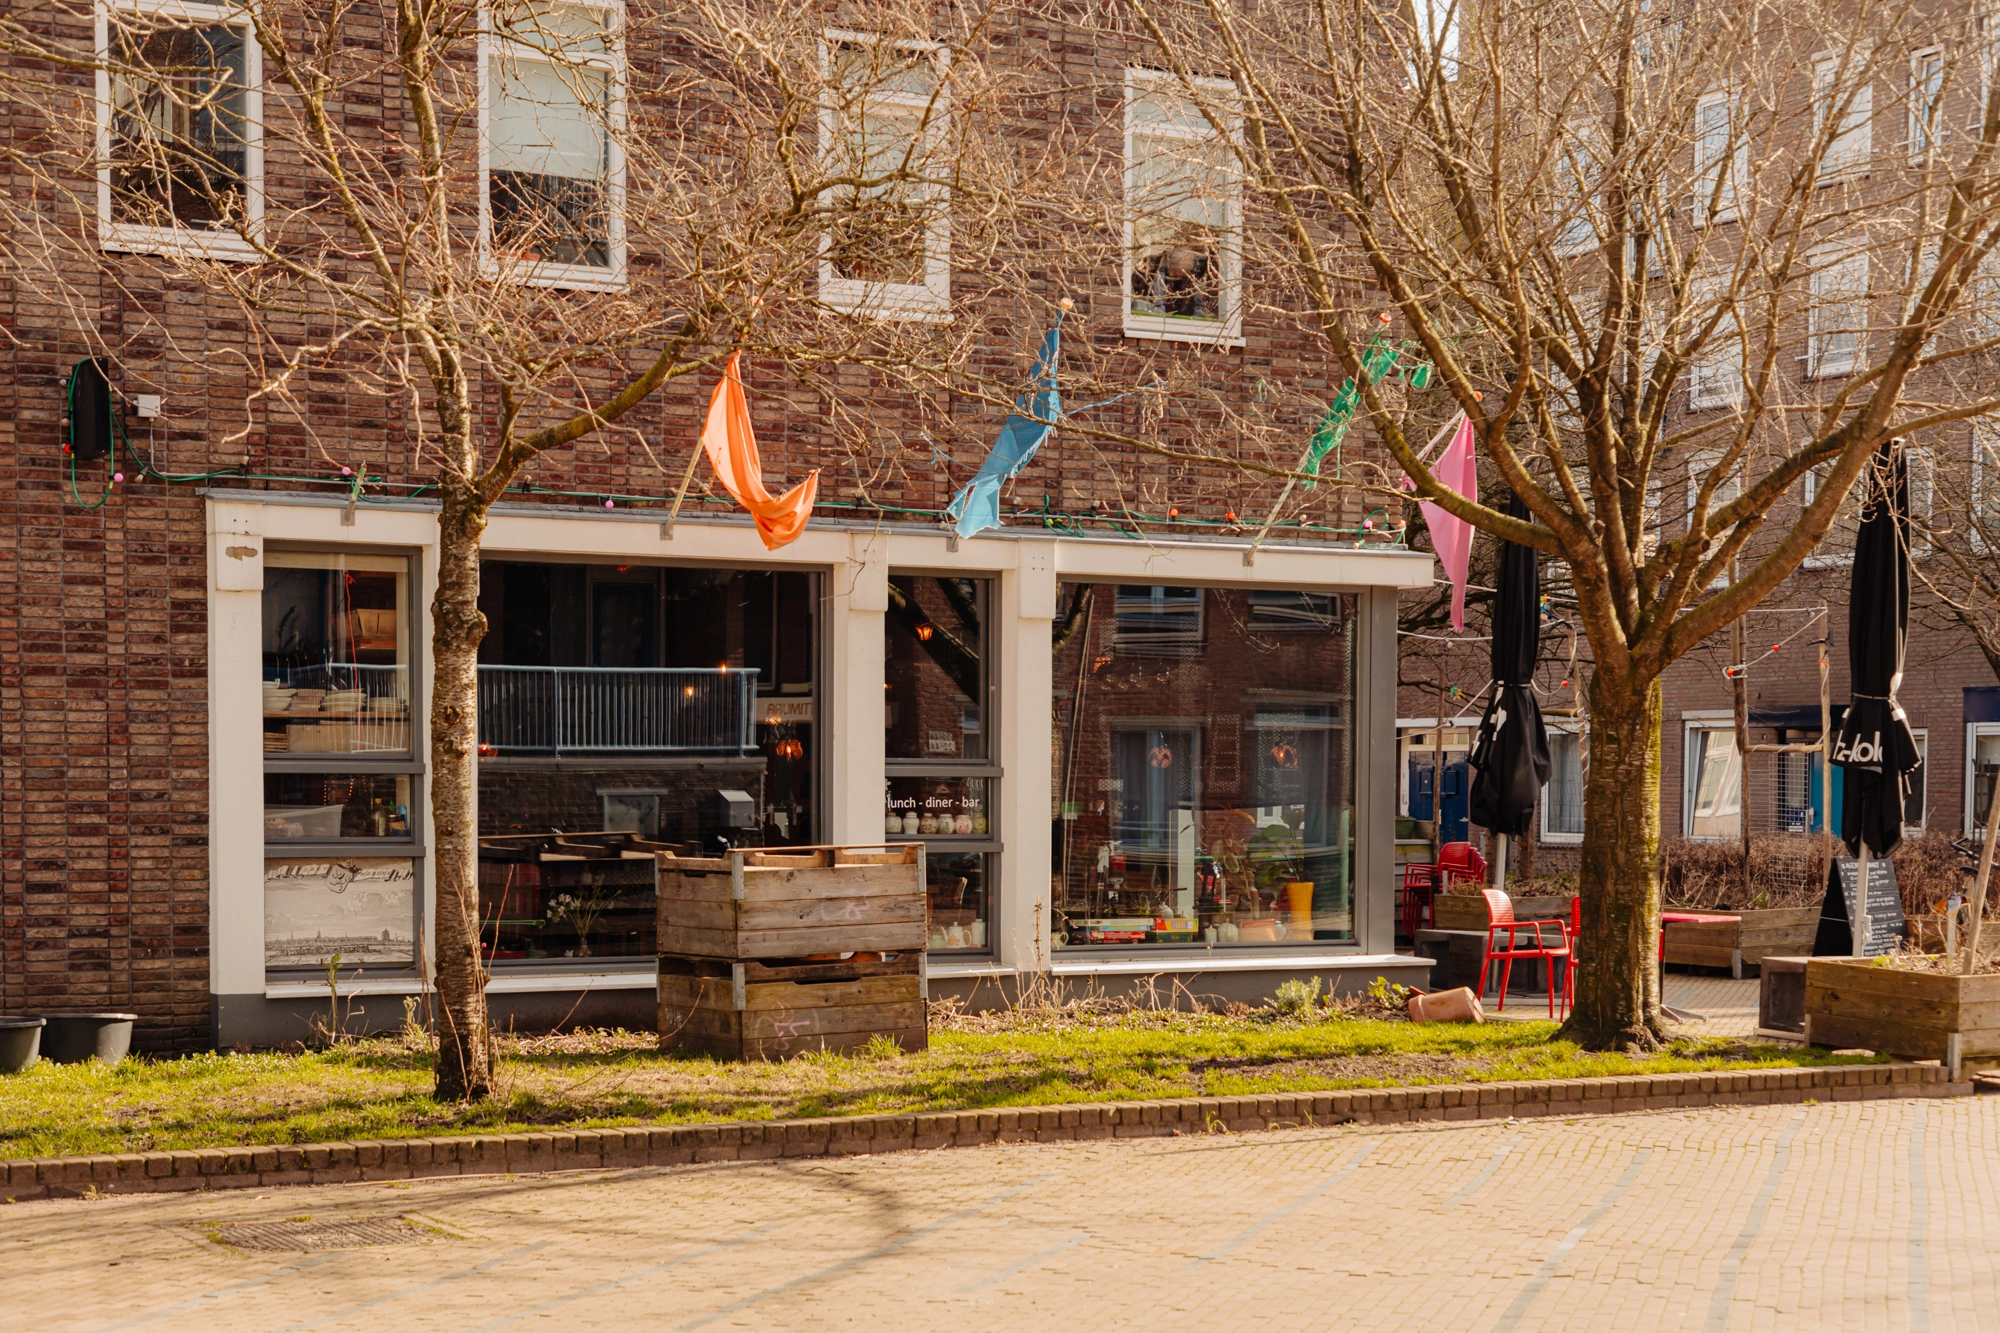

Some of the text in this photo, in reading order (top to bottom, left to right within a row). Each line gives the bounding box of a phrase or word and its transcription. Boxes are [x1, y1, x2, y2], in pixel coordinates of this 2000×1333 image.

[887, 796, 916, 809] lunch
[925, 796, 953, 808] diner
[962, 796, 980, 808] bar
